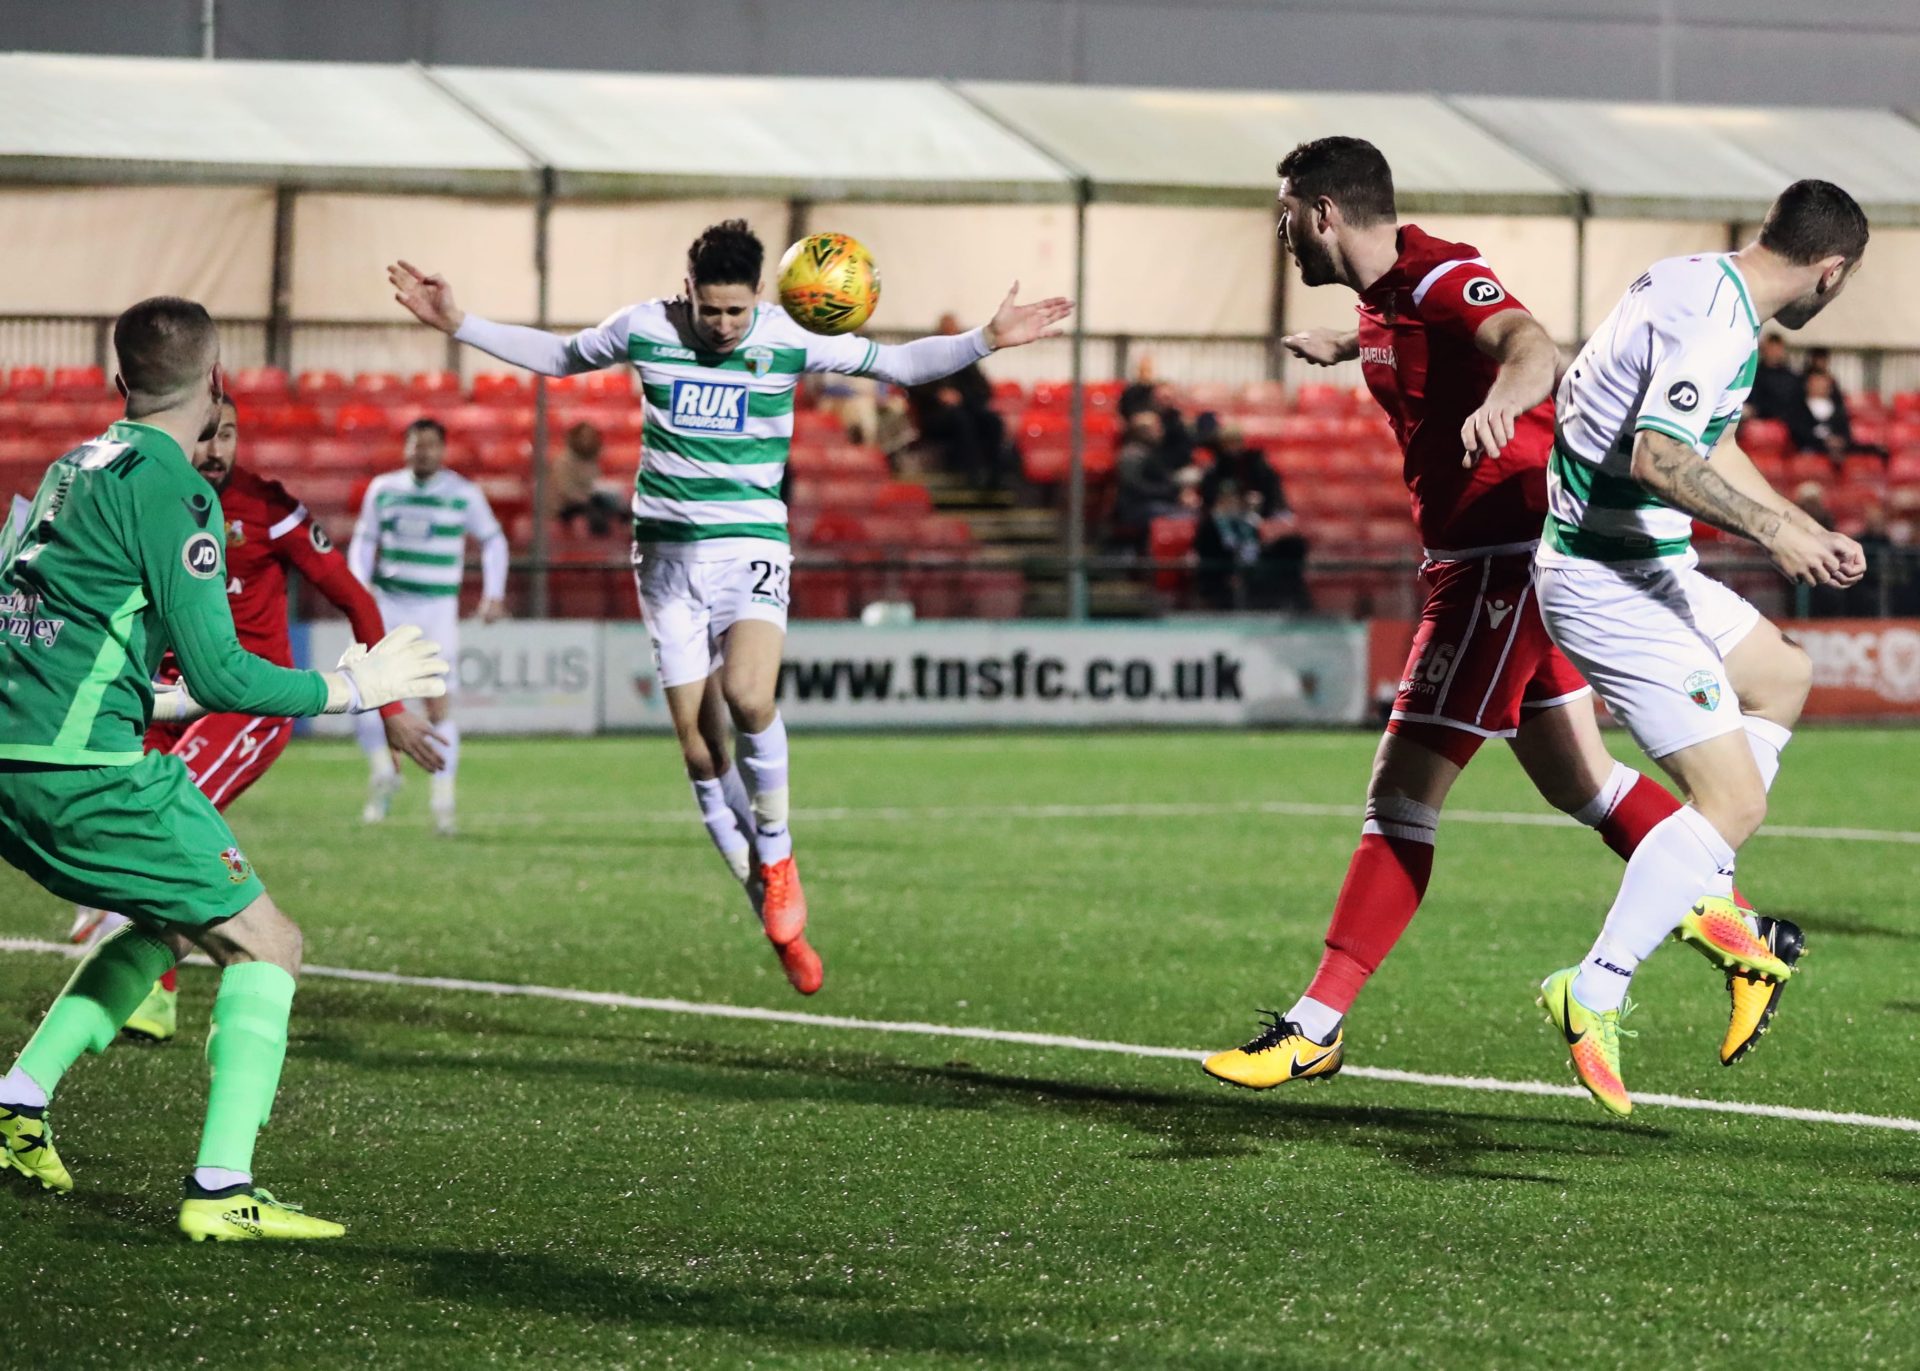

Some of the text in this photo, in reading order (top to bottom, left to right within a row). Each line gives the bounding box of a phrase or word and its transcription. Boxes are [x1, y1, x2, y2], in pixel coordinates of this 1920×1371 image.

[1477, 284, 1496, 300] JD
[675, 383, 746, 418] RUK
[193, 546, 216, 566] JD
[774, 649, 1243, 701] ww.tnsfc.co.uk
[222, 1211, 265, 1237] adidas
